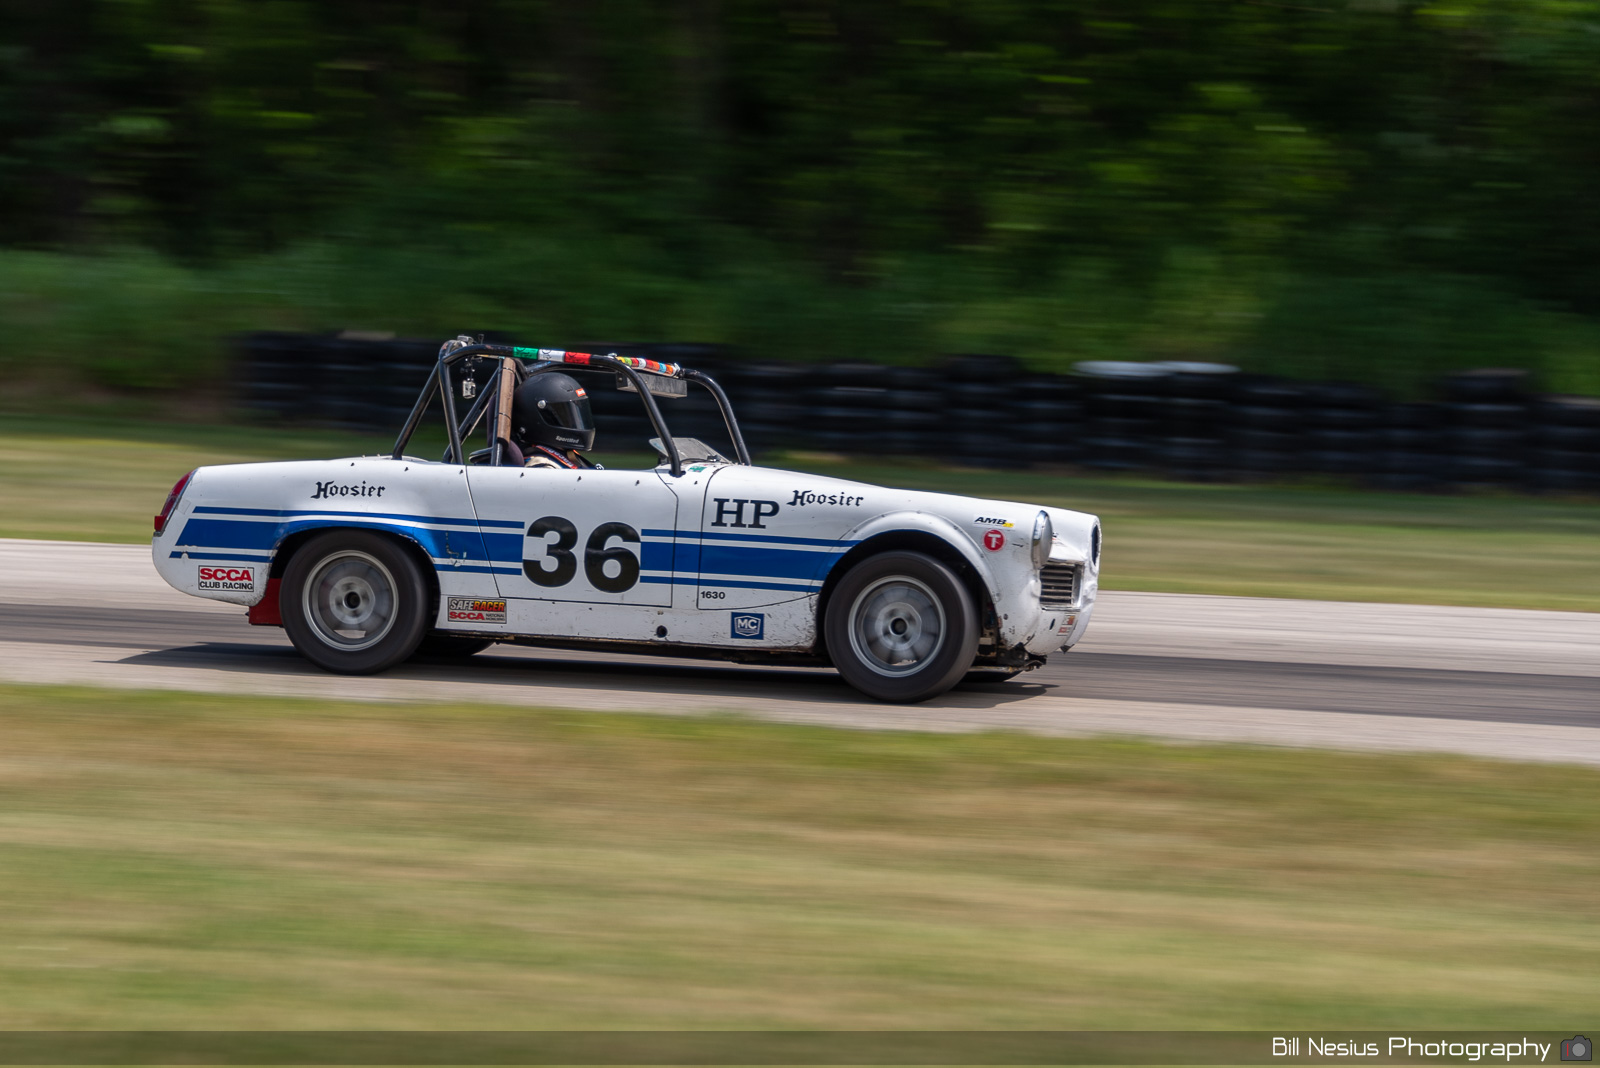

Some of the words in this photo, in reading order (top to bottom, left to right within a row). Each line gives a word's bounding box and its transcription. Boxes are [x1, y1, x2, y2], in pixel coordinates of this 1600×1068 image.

[310, 480, 386, 499] Hoosier
[786, 490, 864, 507] Hoosier
[711, 498, 780, 529] HP
[975, 516, 1006, 525] AMB
[988, 533, 1001, 548] T
[522, 515, 641, 594] 36
[200, 567, 252, 582] SCCA
[199, 581, 221, 589] CLUB
[222, 582, 253, 590] RACING
[700, 591, 726, 600] 1630
[450, 599, 505, 612] SAFERACER
[449, 611, 485, 620] SCCA
[737, 618, 757, 629] MC
